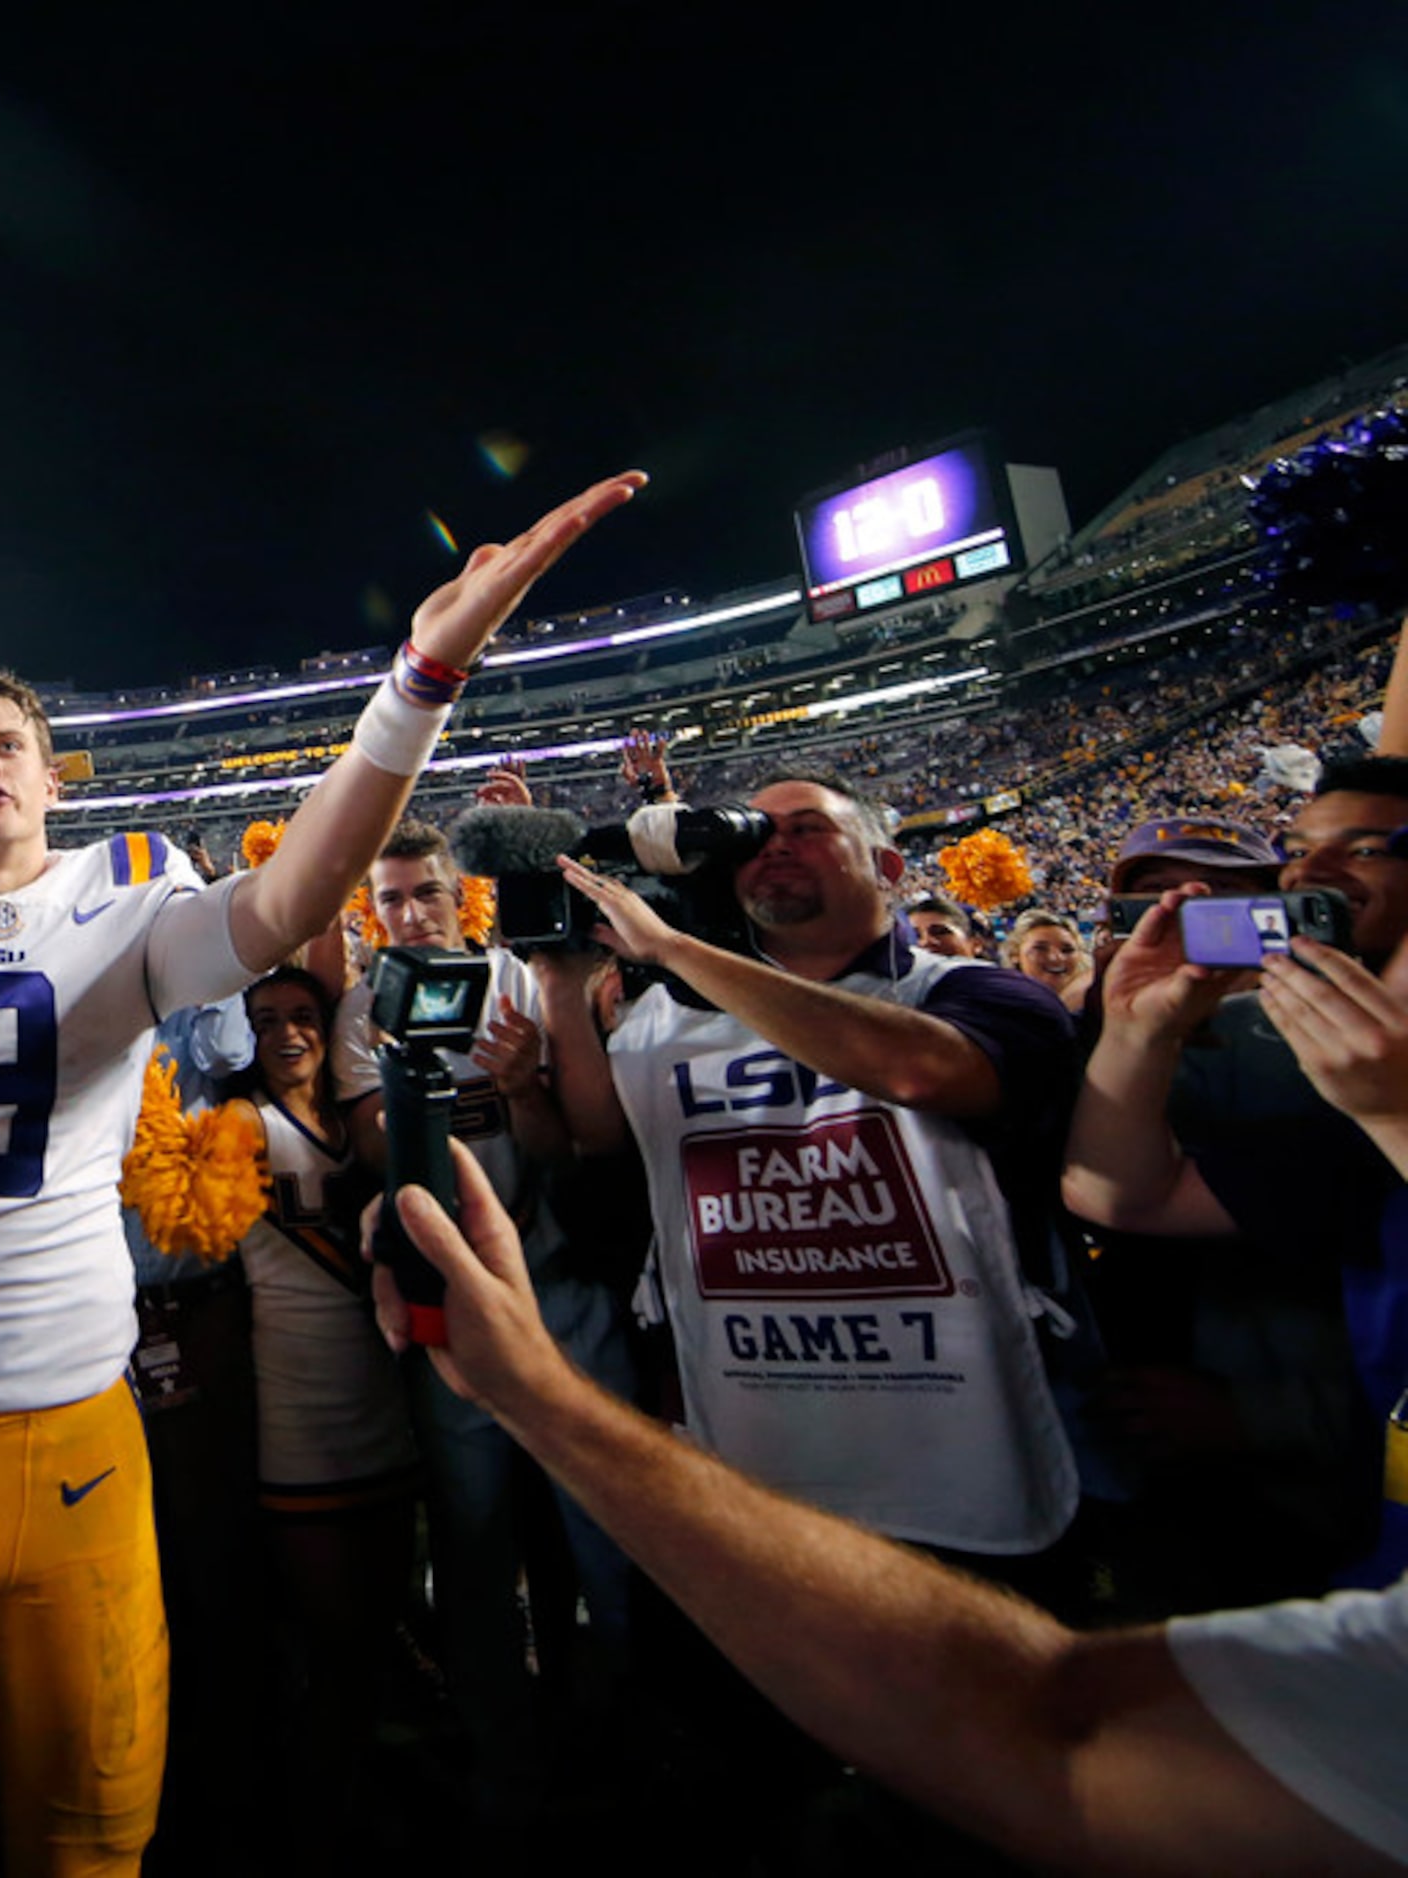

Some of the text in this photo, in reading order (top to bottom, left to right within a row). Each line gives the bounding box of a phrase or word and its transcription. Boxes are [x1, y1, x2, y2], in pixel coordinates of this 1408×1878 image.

[304, 745, 326, 759] TO
[737, 1134, 882, 1188] FARM
[697, 1180, 898, 1235] BUREAU
[735, 1242, 918, 1275] INSURANCE
[724, 1311, 938, 1364] GAME 7
